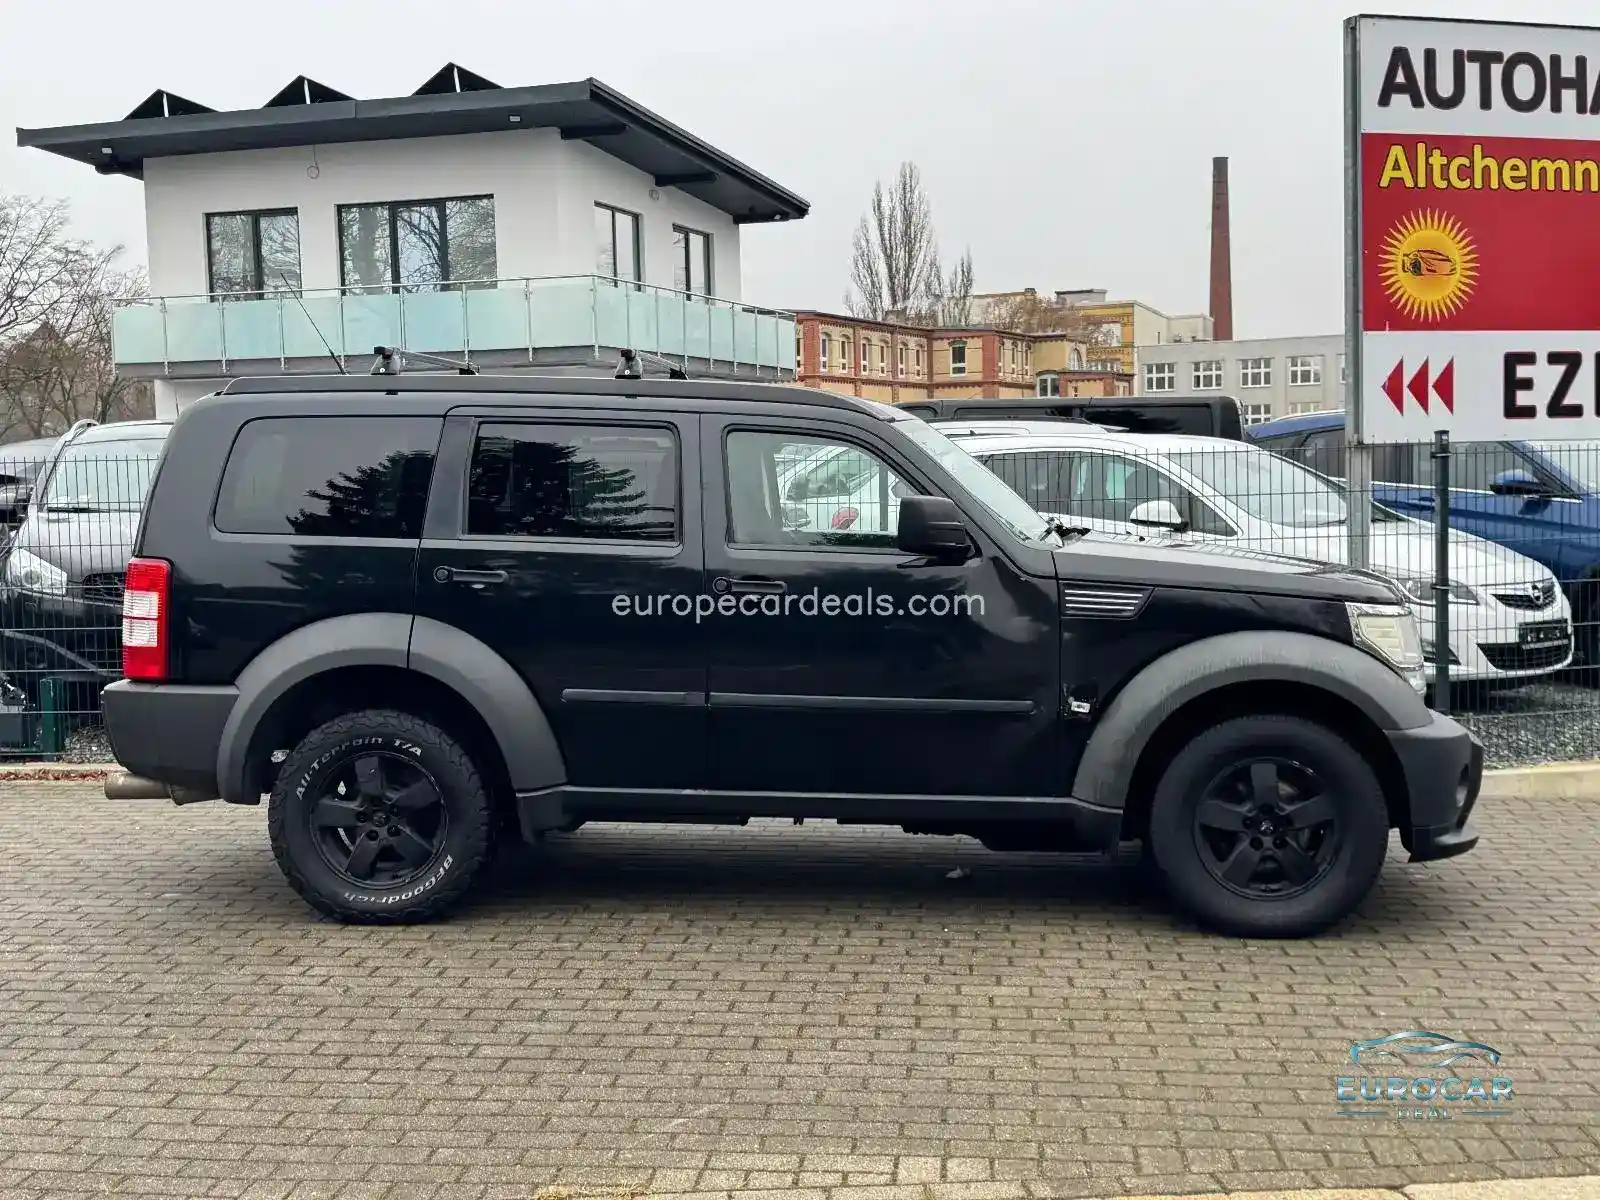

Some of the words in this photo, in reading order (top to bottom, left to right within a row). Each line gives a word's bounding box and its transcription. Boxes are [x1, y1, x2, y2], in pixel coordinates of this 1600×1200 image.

[1377, 46, 1600, 115] AUTOH
[1379, 142, 1599, 192] Altchemn
[1503, 350, 1600, 419] EZ
[296, 736, 383, 800] All-Terrain
[394, 737, 422, 757] T/A
